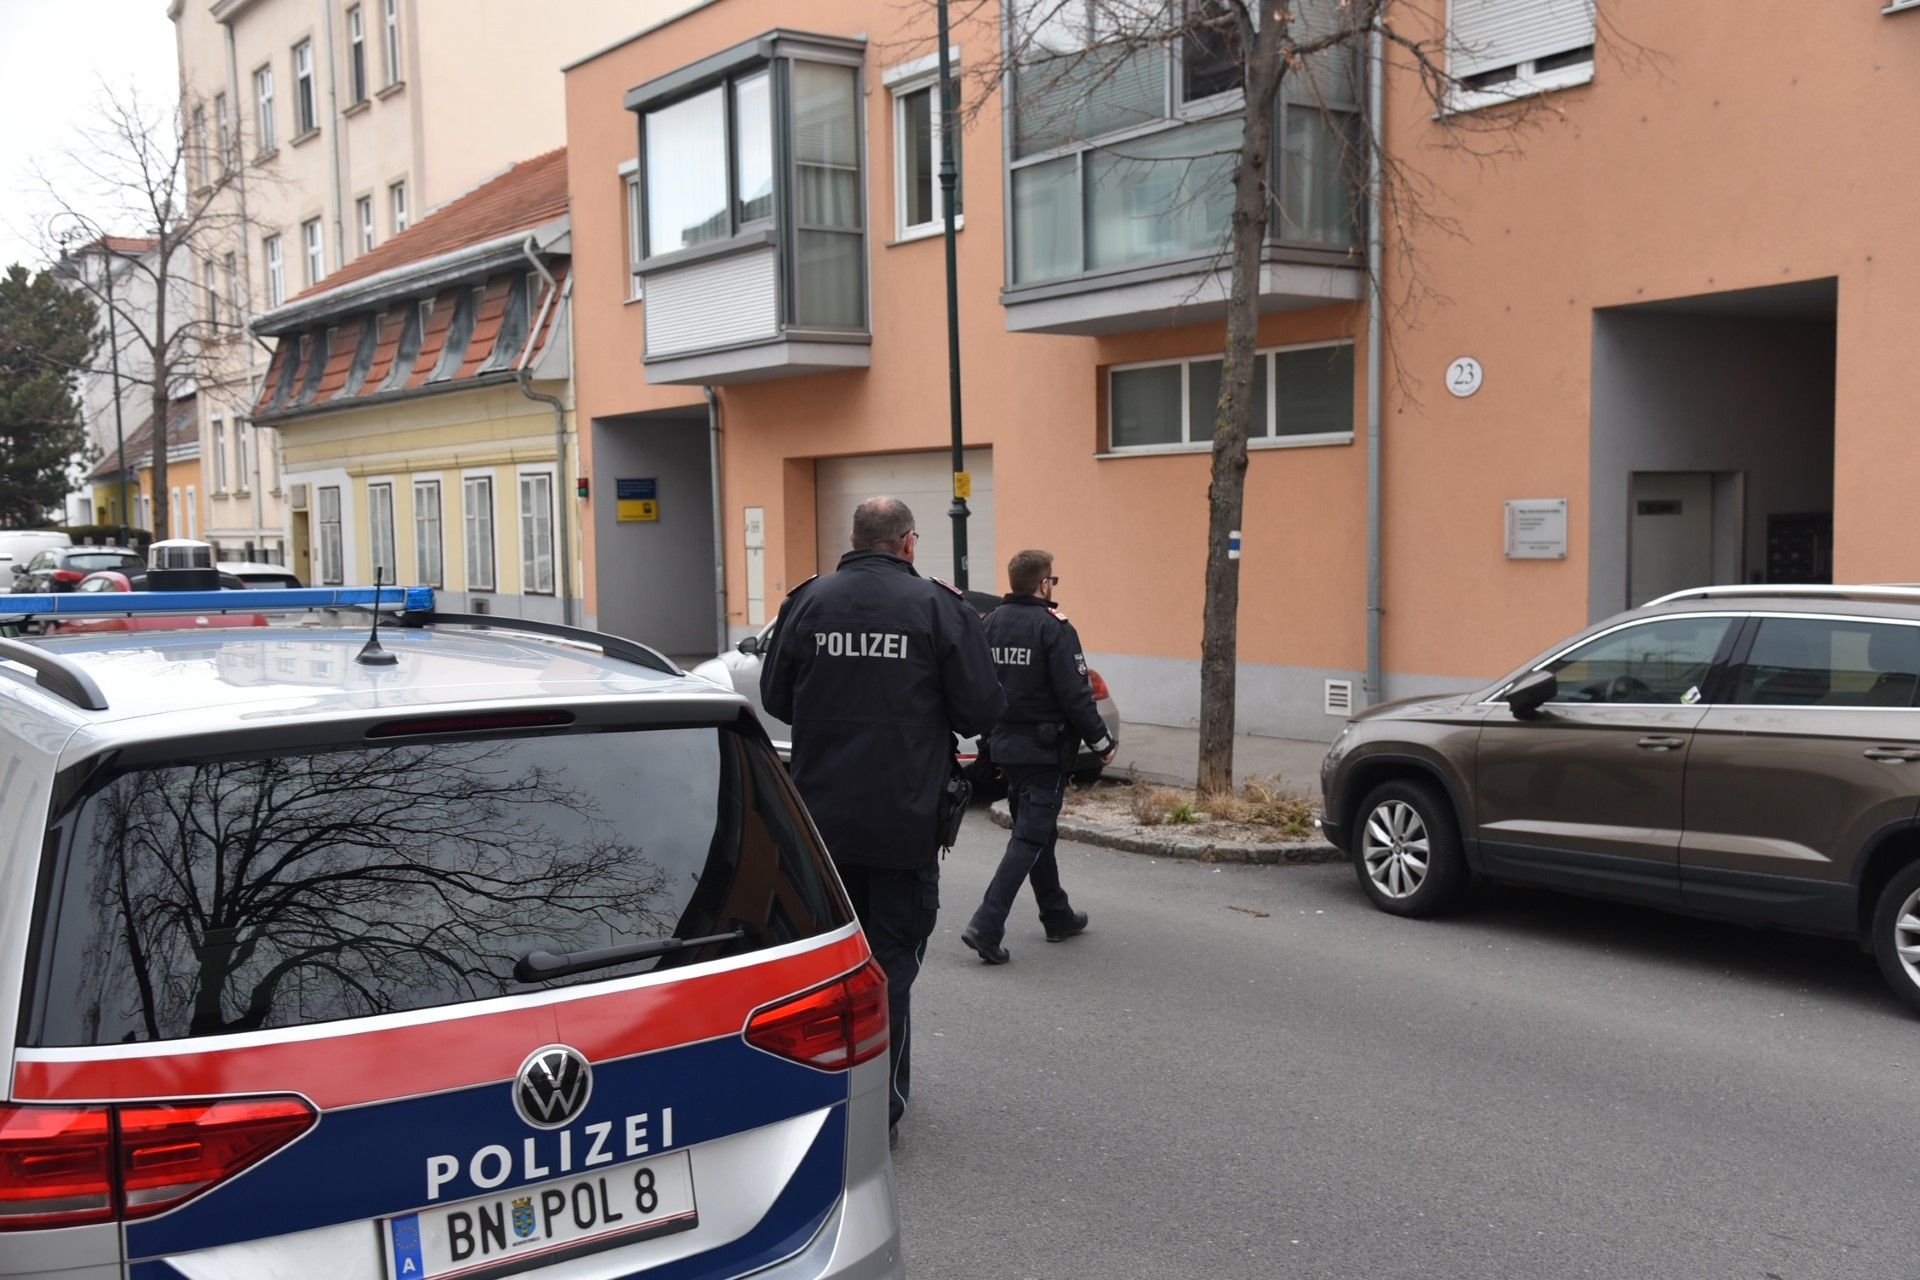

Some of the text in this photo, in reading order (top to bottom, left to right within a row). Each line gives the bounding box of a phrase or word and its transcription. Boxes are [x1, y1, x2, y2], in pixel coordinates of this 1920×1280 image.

[1454, 363, 1474, 385] 23
[815, 631, 908, 659] POLIZEI
[520, 1049, 590, 1121] VW
[426, 1107, 673, 1200] POLIZEI
[447, 1167, 658, 1262] BN POL 8
[402, 1257, 417, 1274] A
